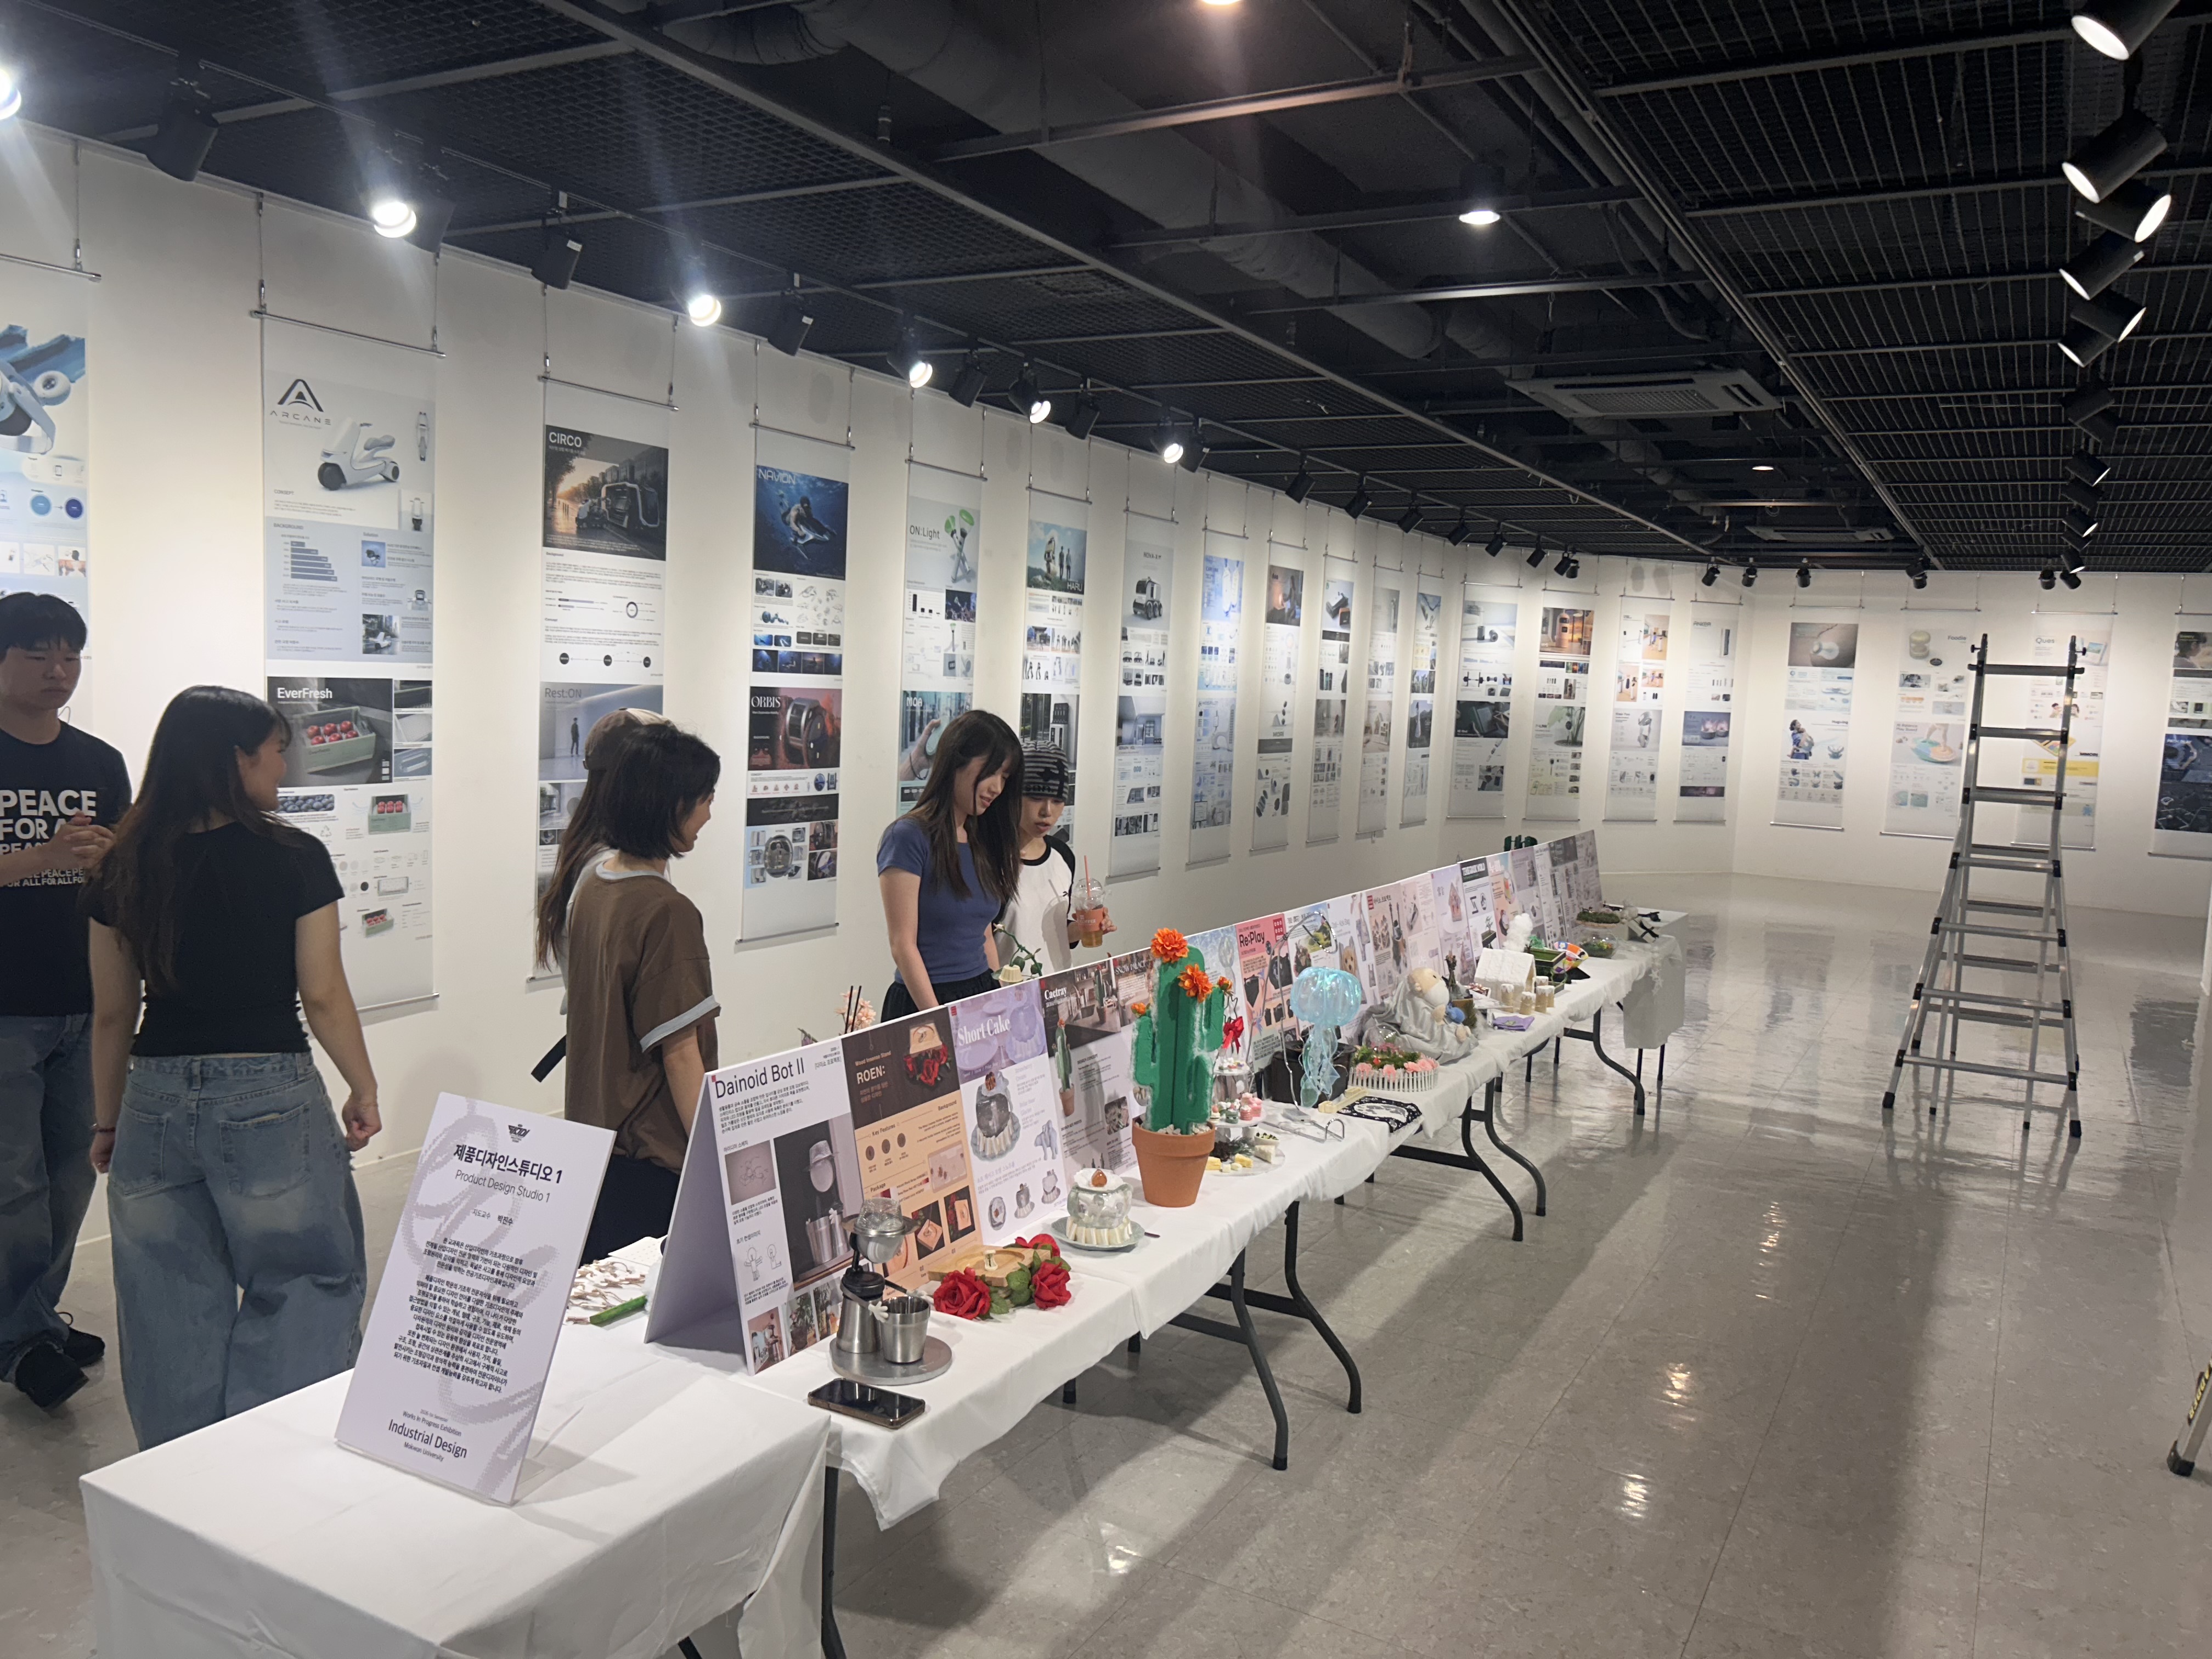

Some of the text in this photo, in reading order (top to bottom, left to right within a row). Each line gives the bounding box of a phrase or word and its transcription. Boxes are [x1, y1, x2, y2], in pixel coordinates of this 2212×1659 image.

[270, 410, 331, 425] ARCANE
[549, 432, 582, 448] CIRCO
[759, 469, 795, 485] NAVION
[1067, 582, 1082, 591] HARU
[277, 687, 332, 699] EverFresh
[751, 696, 781, 708] ORBIS
[0, 789, 97, 817] PEACE
[0, 817, 49, 840] FOR
[1239, 931, 1265, 948] Re:Play
[957, 1015, 1011, 1046] Short Cake
[714, 1067, 767, 1098] Dainoid
[771, 1062, 793, 1081] Bot
[856, 1065, 886, 1085] ROEN:
[454, 1144, 562, 1183] 제품디자인스튜디오 1
[455, 1169, 550, 1203] Product Design Studio 1
[870, 1183, 886, 1193] Package
[472, 1209, 512, 1225] 지도교수 박진수
[388, 1419, 466, 1458] Industrial Design
